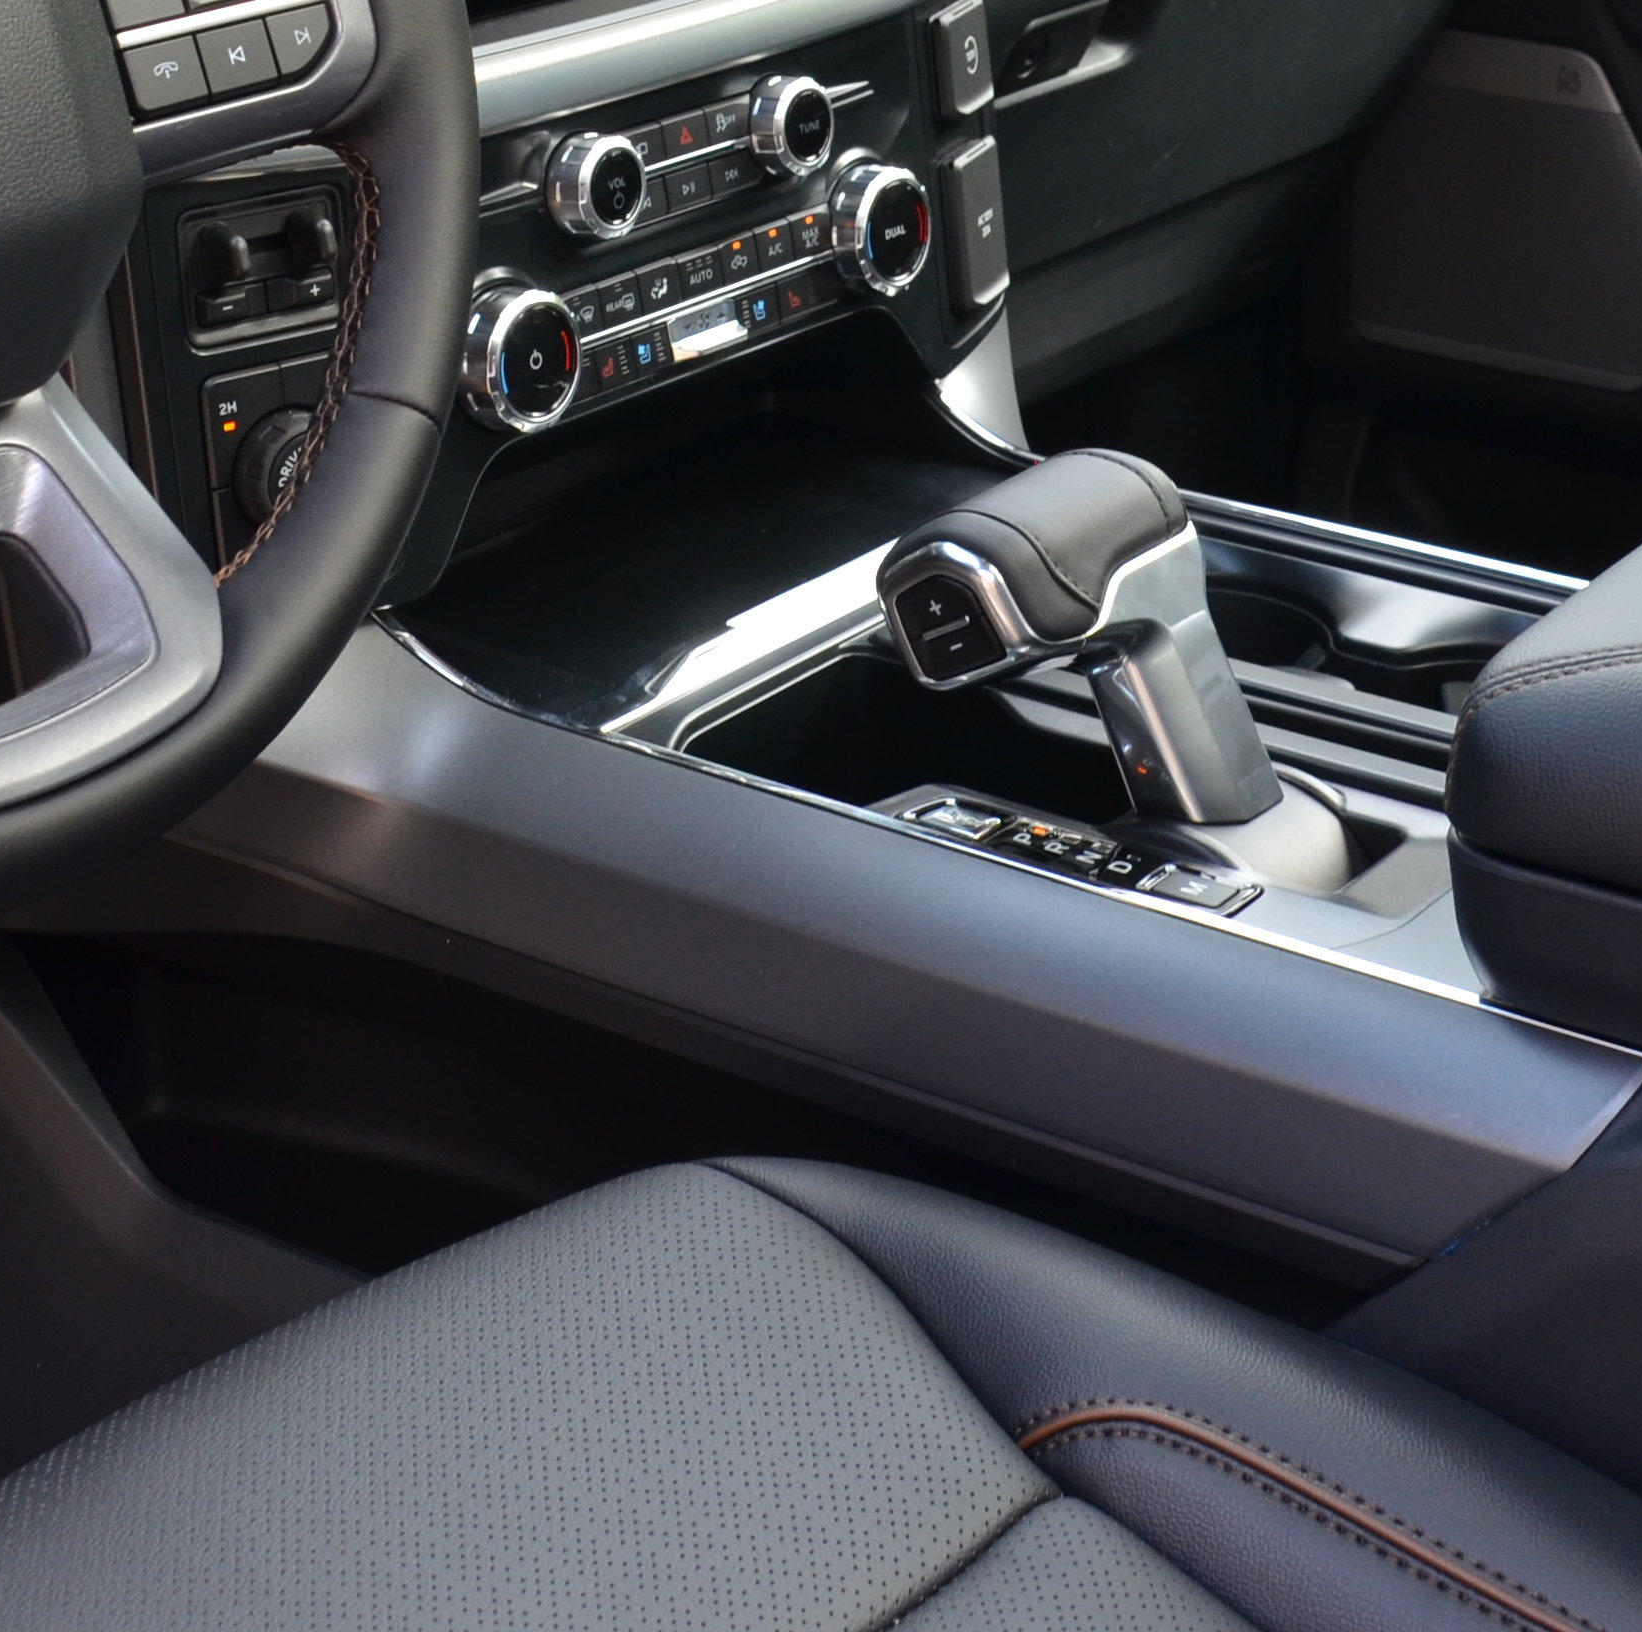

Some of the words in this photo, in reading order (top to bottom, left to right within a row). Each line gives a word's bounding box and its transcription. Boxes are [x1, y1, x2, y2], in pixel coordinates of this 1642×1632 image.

[799, 120, 822, 135] TUNE
[607, 176, 627, 191] VOL
[884, 224, 907, 241] DUAL
[768, 241, 783, 258] A/C
[689, 268, 714, 286] AUTO
[217, 400, 238, 417] 2H
[1013, 831, 1033, 847] P
[1044, 840, 1070, 856] R
[1075, 849, 1104, 866] N
[1107, 859, 1134, 875] D
[1181, 880, 1209, 897] M
